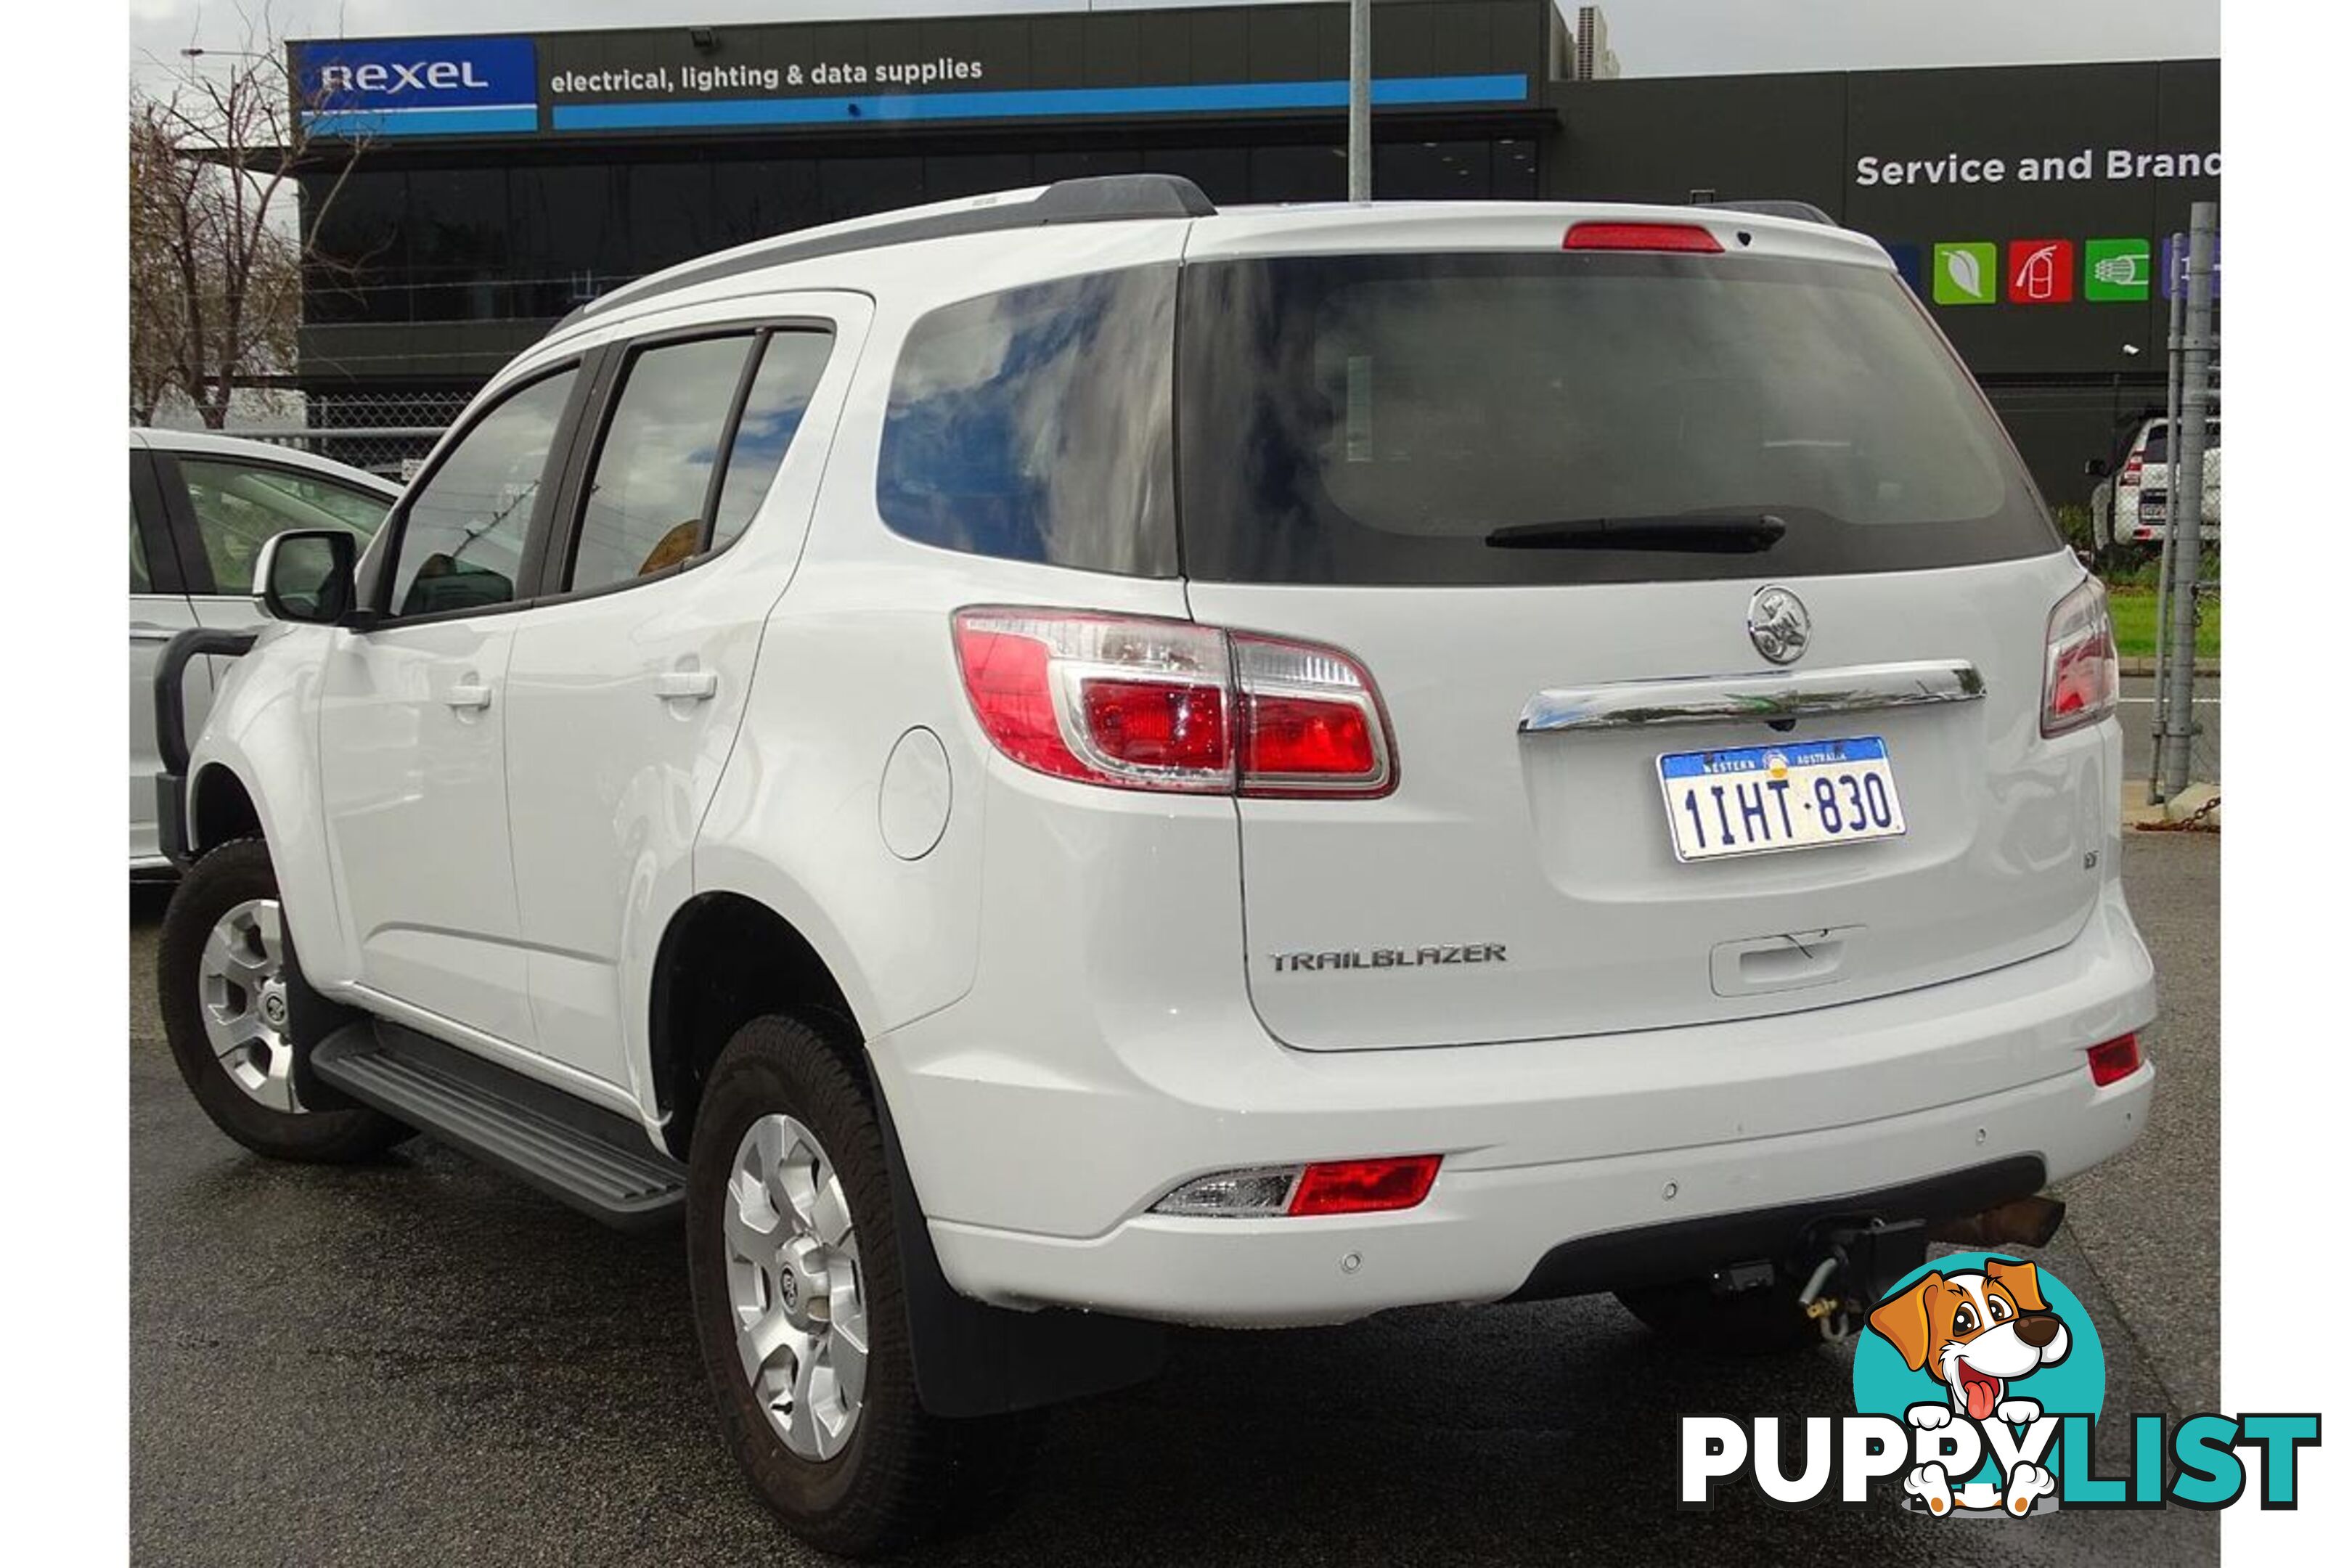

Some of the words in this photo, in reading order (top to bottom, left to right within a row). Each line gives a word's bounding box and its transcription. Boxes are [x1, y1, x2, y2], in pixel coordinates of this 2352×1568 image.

[551, 68, 674, 92] electrical,
[681, 65, 780, 91] lighting
[786, 64, 804, 86] &
[811, 62, 868, 84] data
[875, 57, 983, 85] supplies
[1855, 153, 2006, 186] Service
[2017, 150, 2093, 181] and
[1270, 944, 1507, 972] TRAILBLAZER
